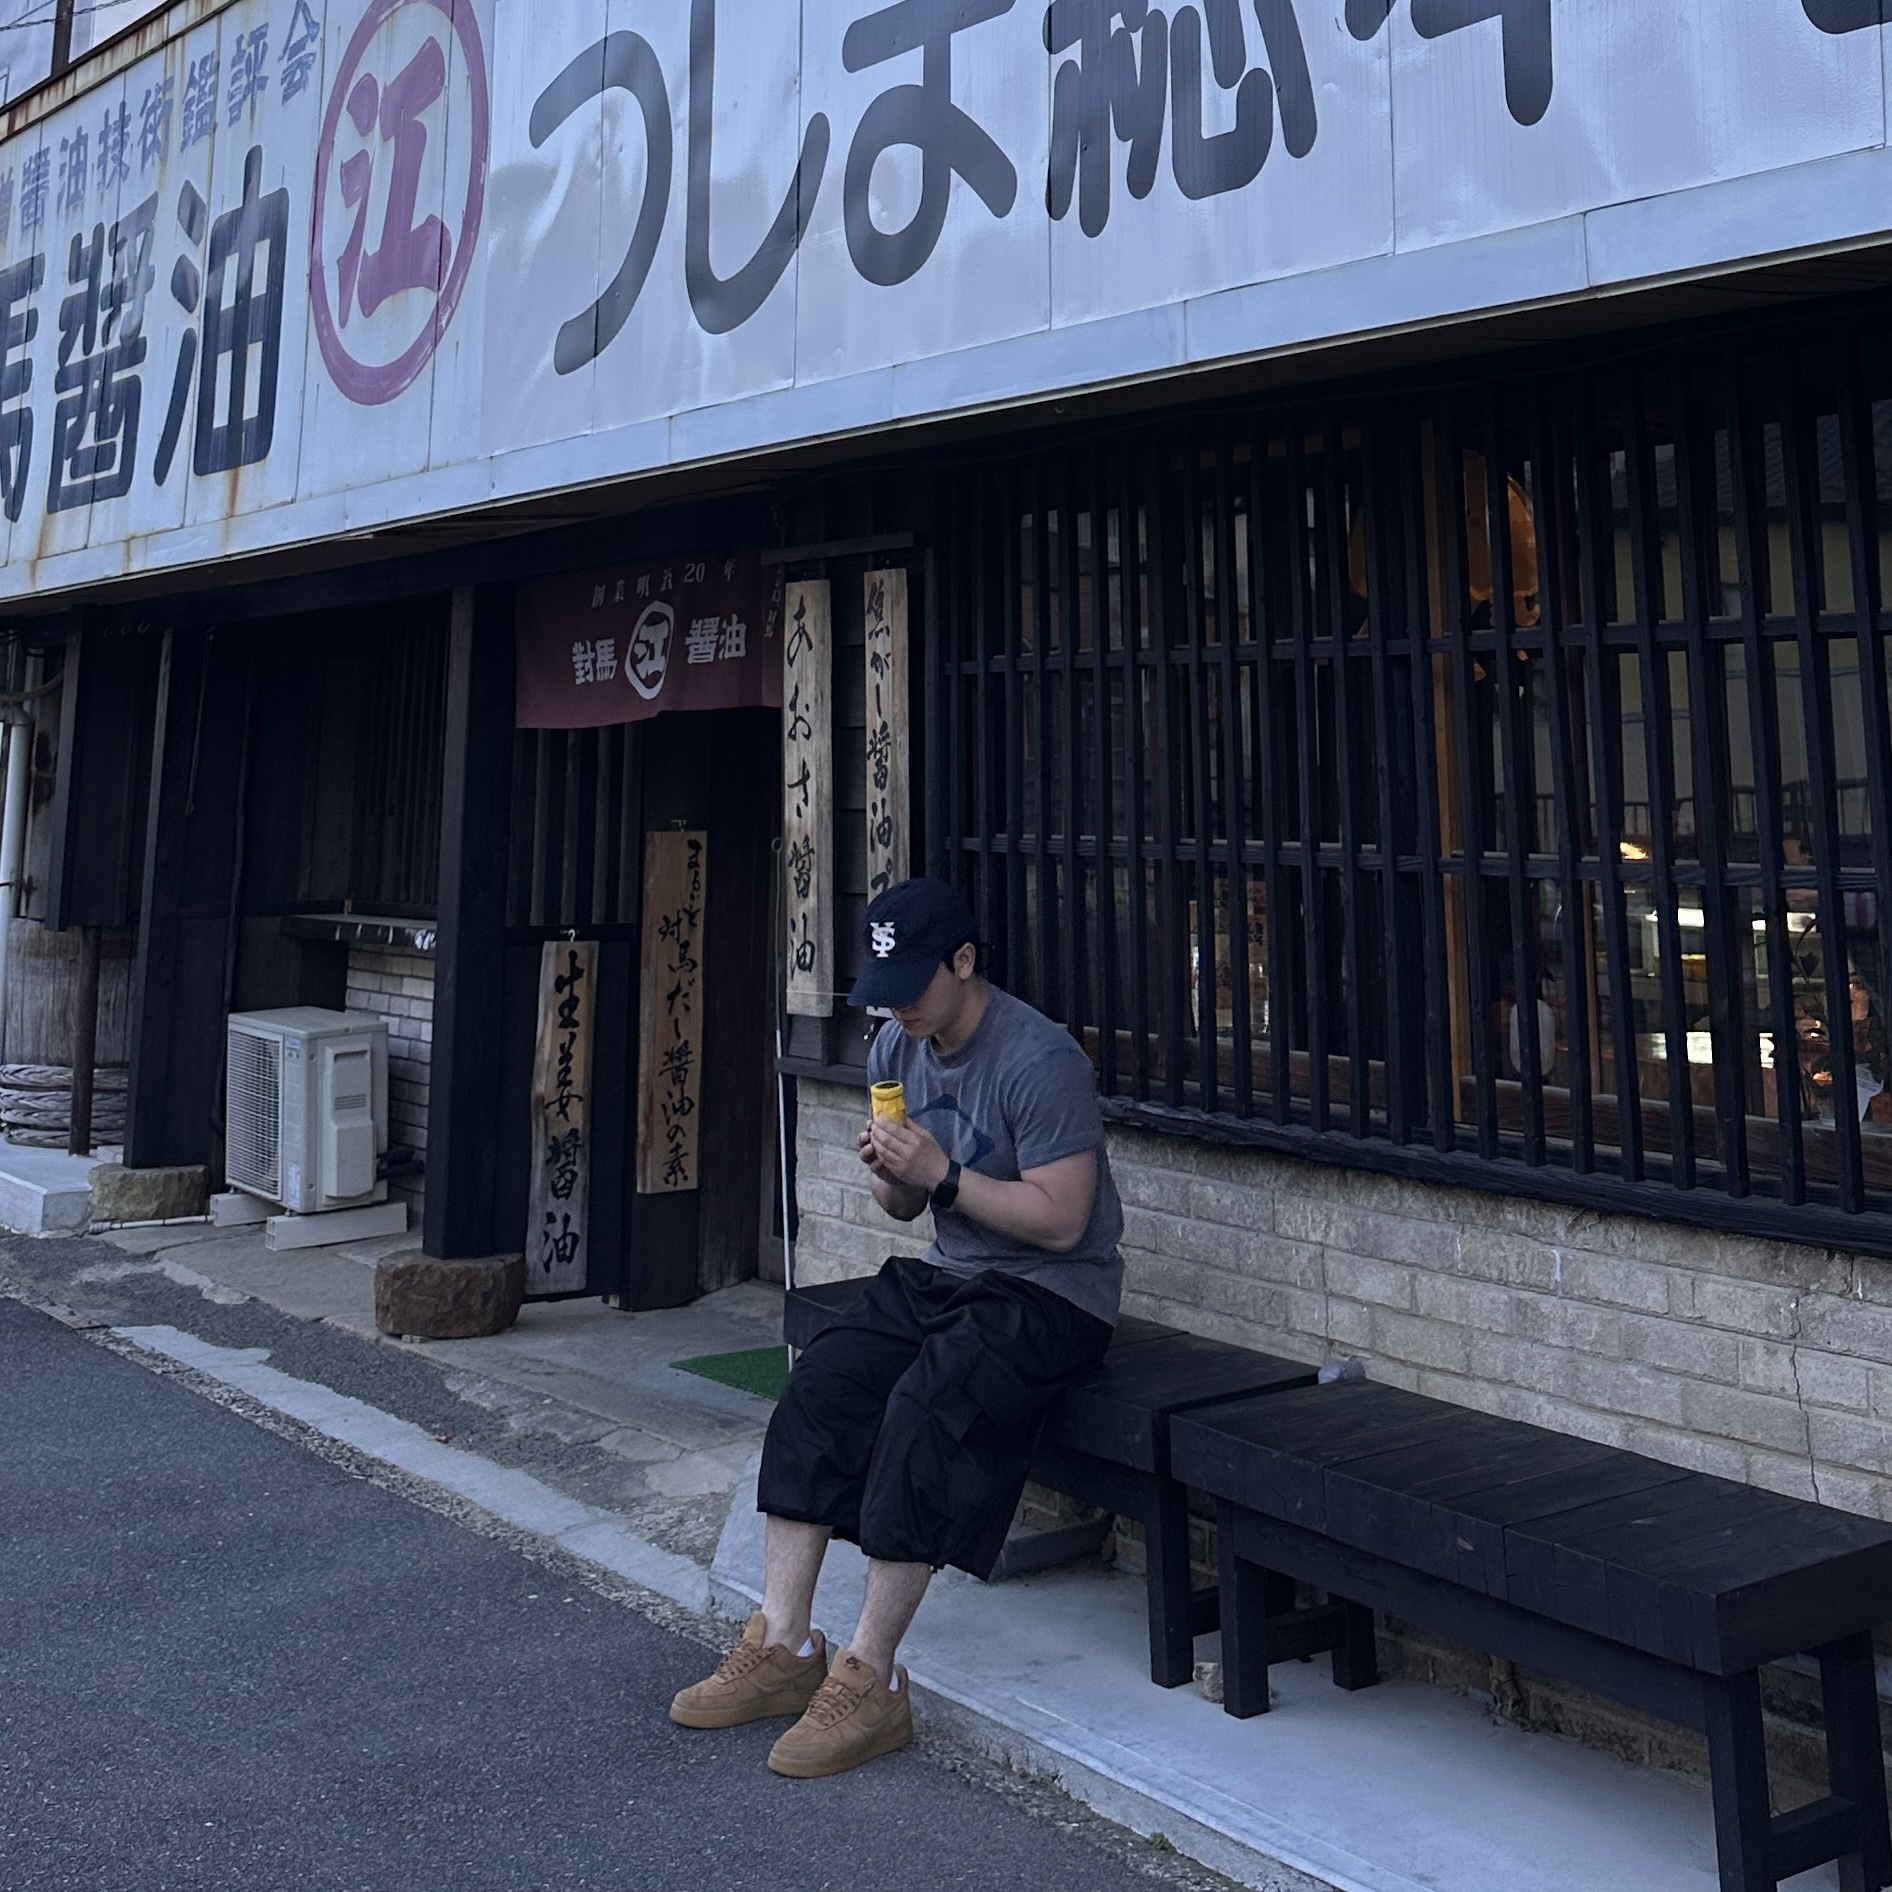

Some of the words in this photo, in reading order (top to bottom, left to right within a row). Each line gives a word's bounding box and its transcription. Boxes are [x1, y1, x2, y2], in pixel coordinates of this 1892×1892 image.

[335, 35, 456, 330] 江
[866, 581, 895, 891] 焦がし醤油プ
